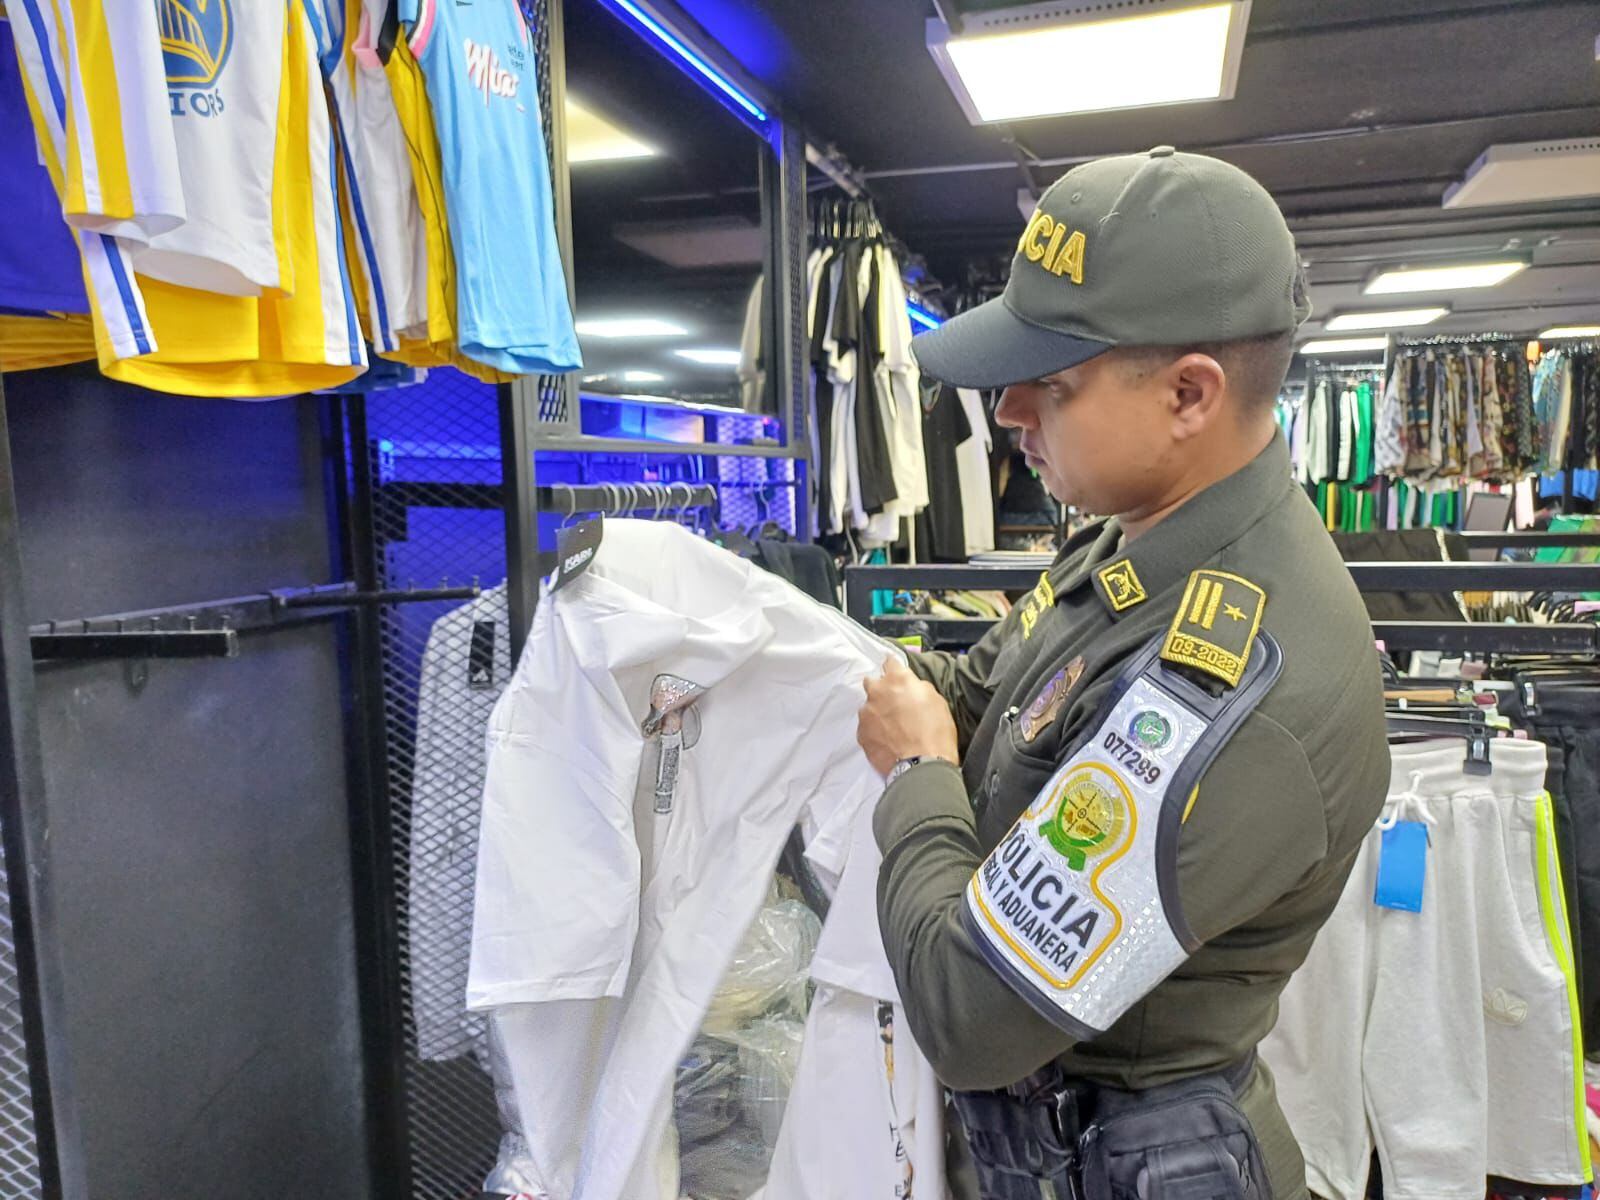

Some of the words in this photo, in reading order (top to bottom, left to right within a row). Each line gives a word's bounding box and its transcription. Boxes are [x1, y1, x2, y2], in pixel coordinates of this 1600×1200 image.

[1170, 637, 1238, 674] 09-2022
[1103, 731, 1161, 784] 077299
[992, 878, 1010, 899] Y
[997, 891, 1079, 973] ADUANERA
